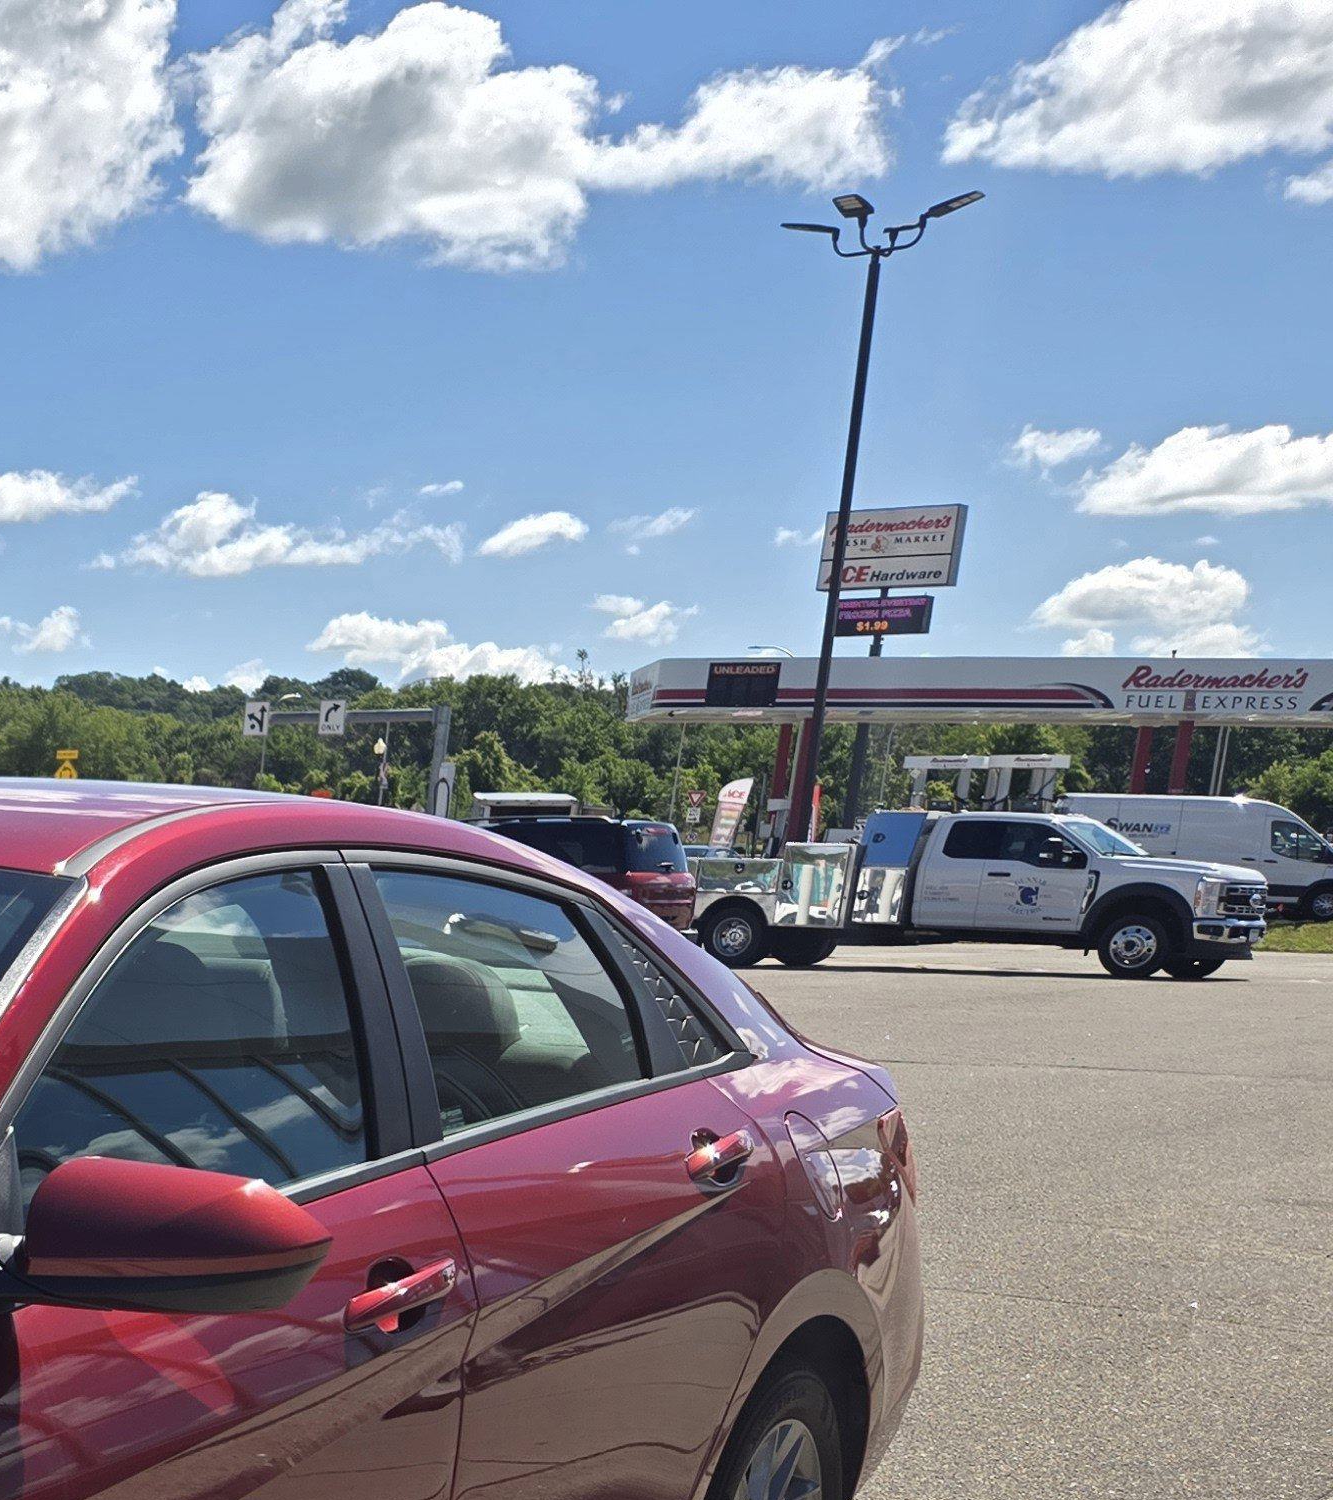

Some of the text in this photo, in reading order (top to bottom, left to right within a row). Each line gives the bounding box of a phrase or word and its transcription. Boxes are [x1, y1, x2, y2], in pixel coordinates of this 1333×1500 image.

[830, 515, 952, 535] adermacher's
[894, 534, 945, 544] MARKET
[870, 569, 942, 583] Hardware
[856, 621, 889, 632] $1.99
[714, 665, 775, 675] UNLEADED
[1122, 665, 1309, 690] Radermacher's
[1125, 695, 1298, 711] FUEL EXPRESS
